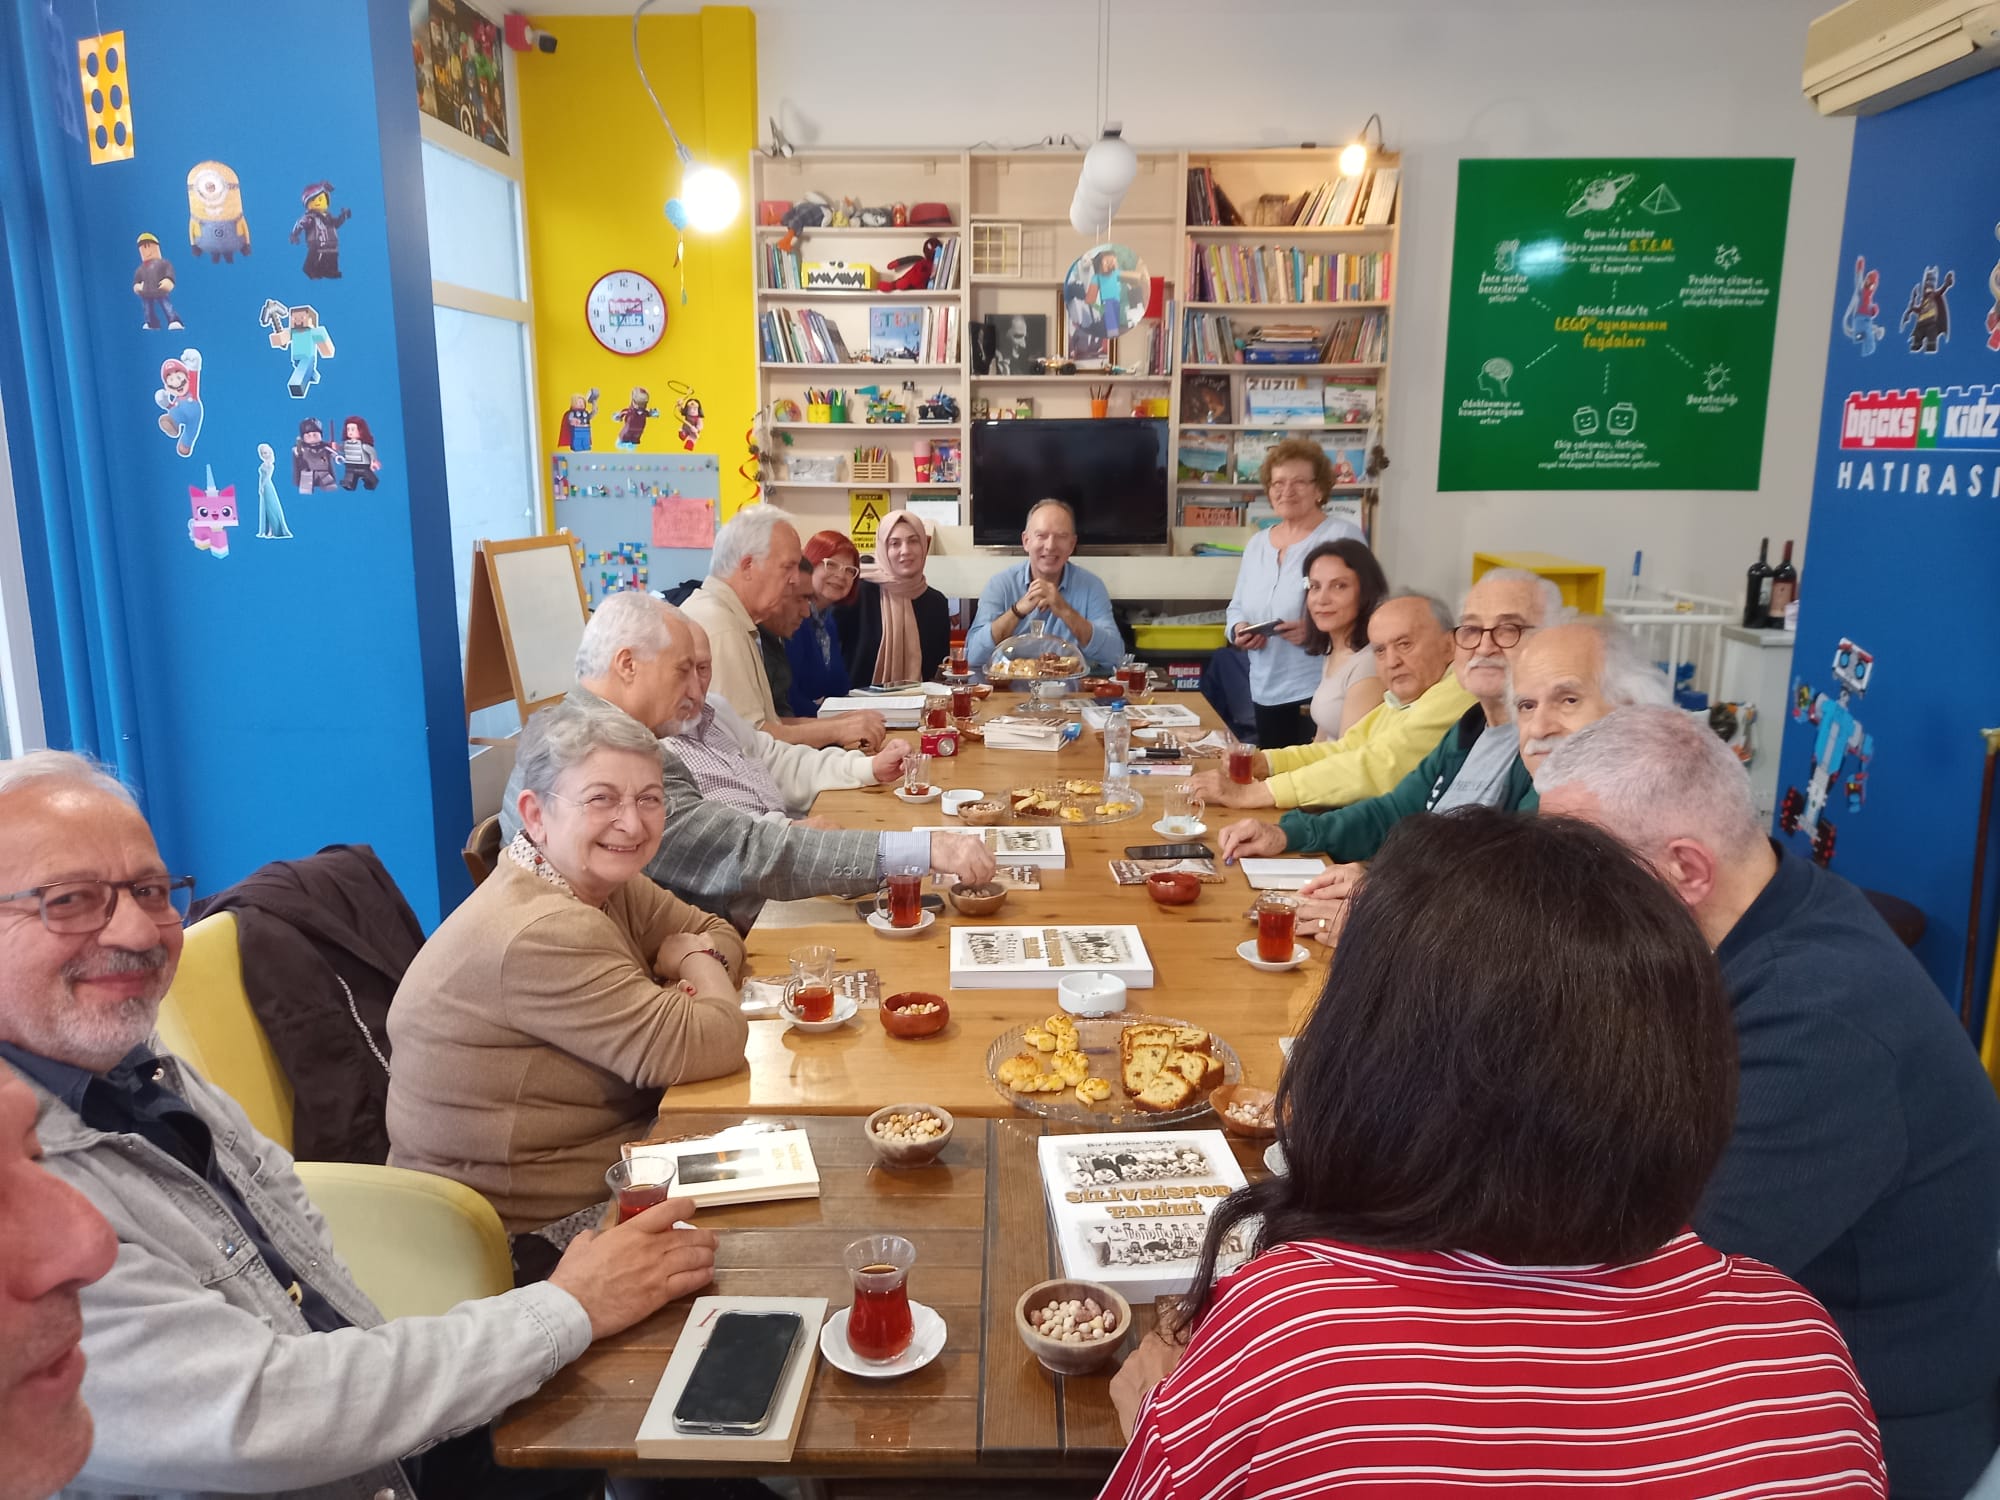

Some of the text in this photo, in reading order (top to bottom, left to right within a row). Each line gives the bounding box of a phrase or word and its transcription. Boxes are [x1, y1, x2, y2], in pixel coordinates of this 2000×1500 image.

[1919, 405, 1939, 438] 4
[1064, 1184, 1233, 1204] SİLİVRİSPOR
[1106, 1200, 1206, 1219] TARİHİ
